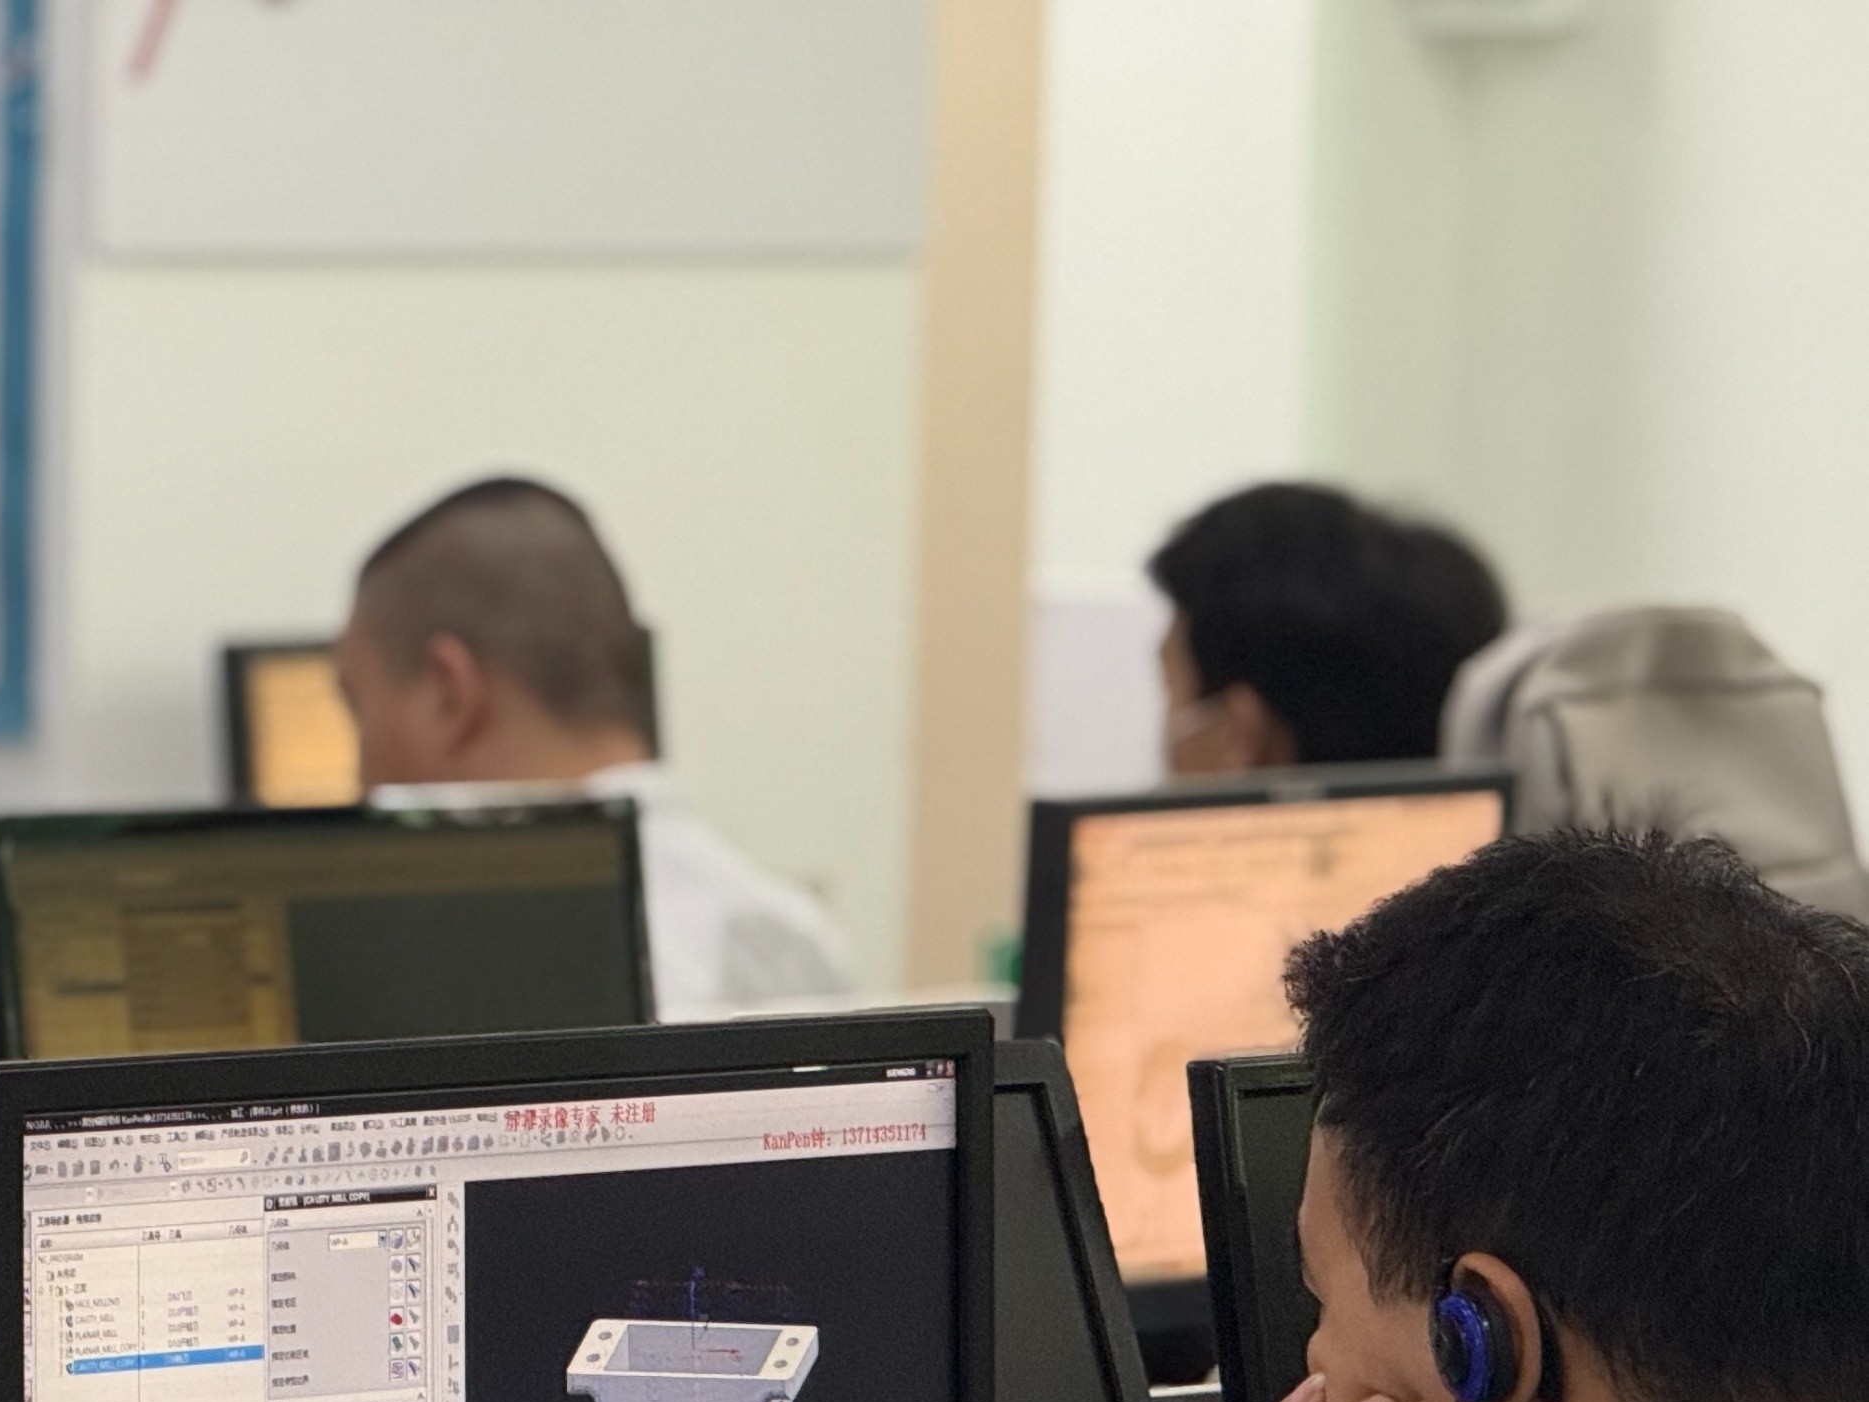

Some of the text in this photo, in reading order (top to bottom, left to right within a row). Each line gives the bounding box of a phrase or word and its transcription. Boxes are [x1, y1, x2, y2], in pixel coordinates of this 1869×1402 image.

[610, 1101, 656, 1125] 未注册
[842, 1122, 927, 1146] 13714351174
